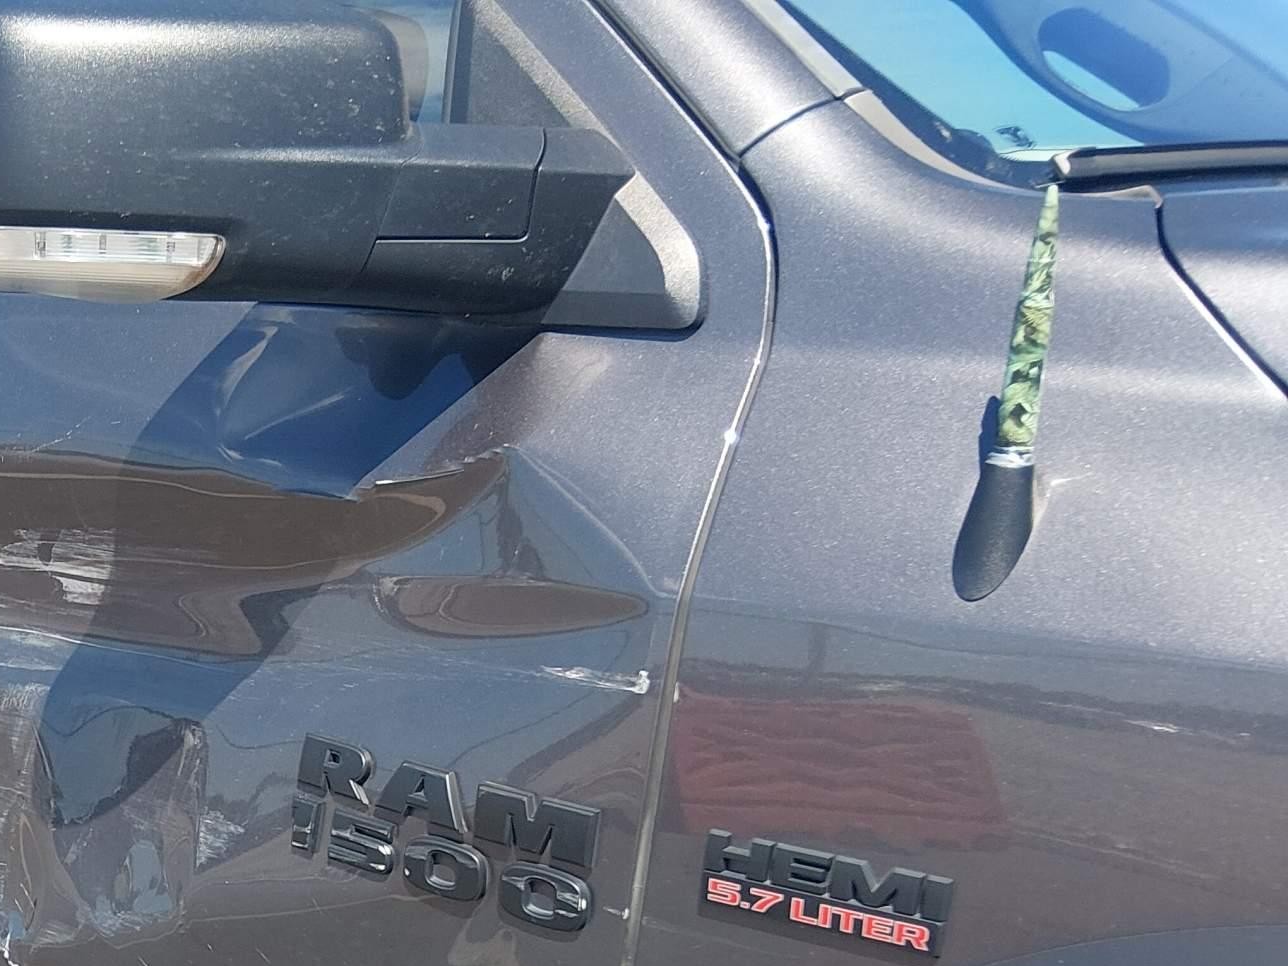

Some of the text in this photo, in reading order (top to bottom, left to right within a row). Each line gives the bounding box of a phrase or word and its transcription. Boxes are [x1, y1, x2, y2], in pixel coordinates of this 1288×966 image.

[296, 732, 601, 867] RAM
[291, 796, 593, 931] 1500
[704, 828, 954, 923] HEMI
[707, 878, 930, 951] 5.7 LITER
